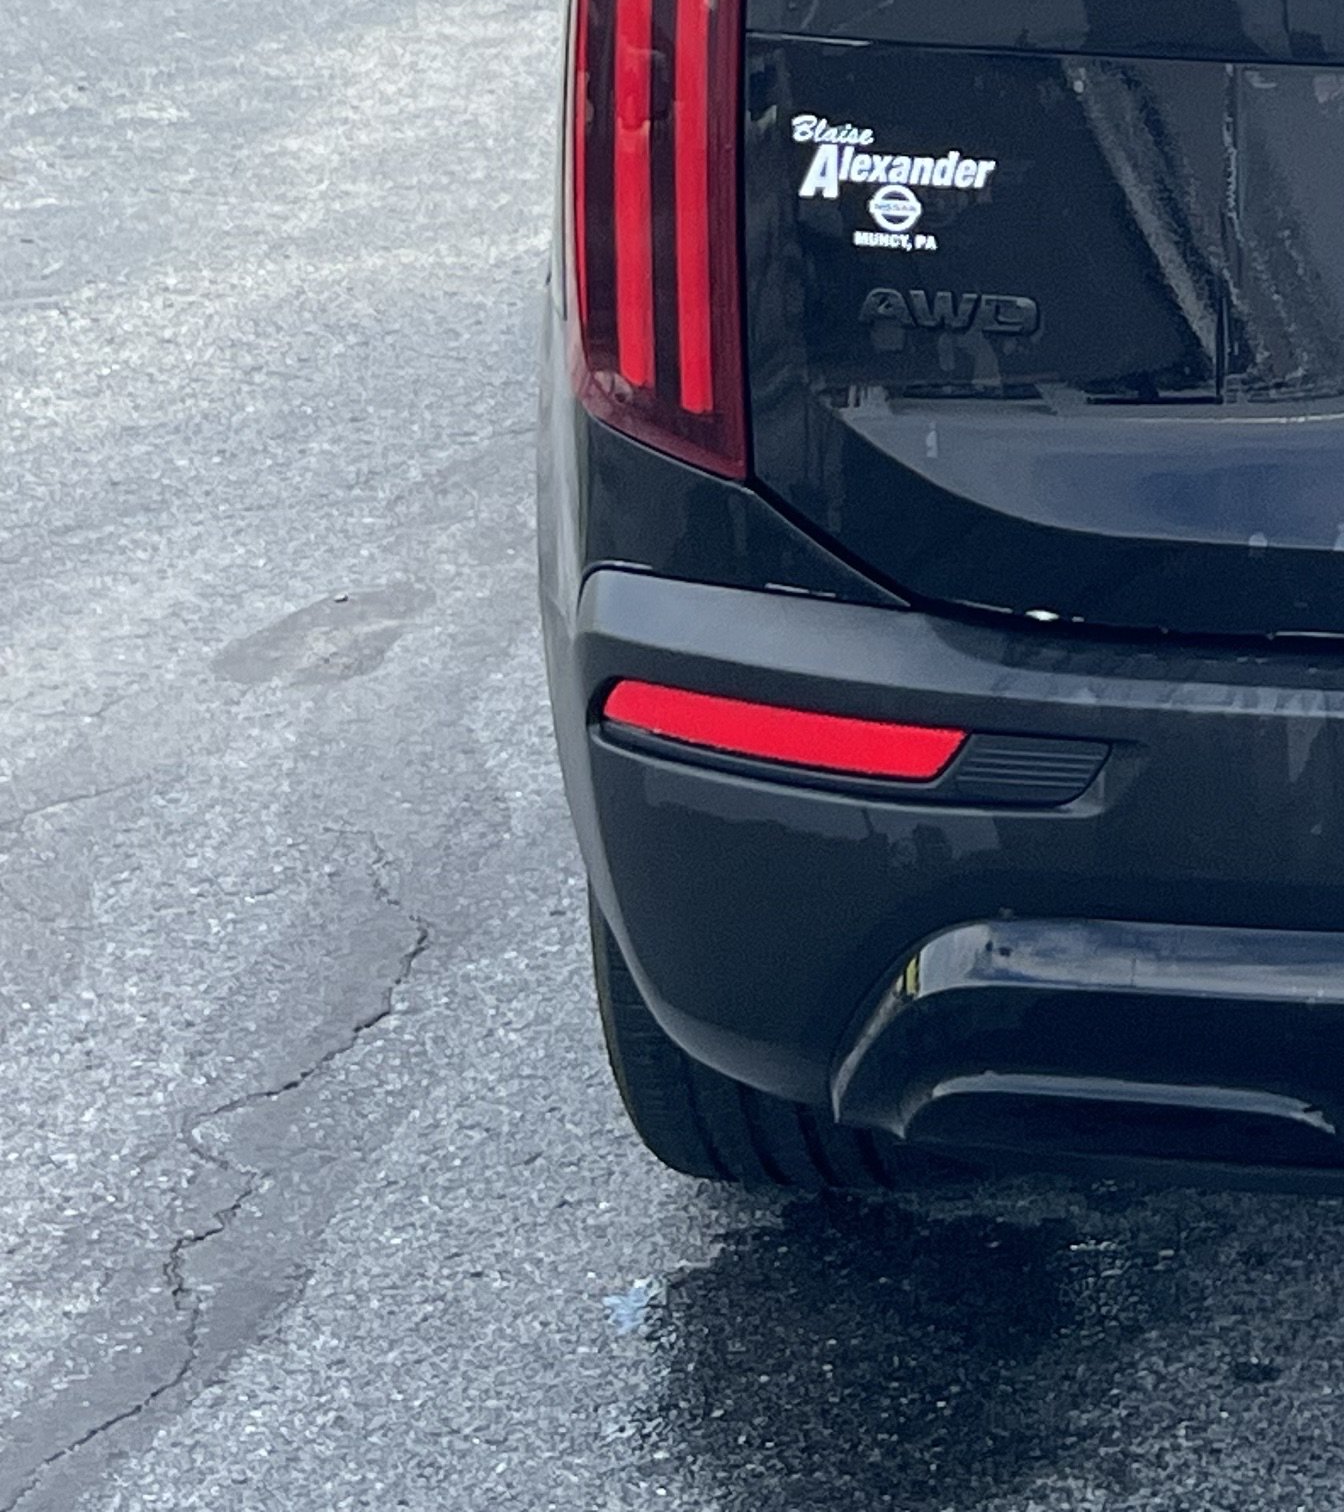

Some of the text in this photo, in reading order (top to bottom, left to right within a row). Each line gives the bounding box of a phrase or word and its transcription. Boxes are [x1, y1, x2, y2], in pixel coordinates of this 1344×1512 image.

[791, 114, 875, 146] Blaise
[799, 143, 997, 199] Alexander
[853, 231, 938, 252] MUNCY, PA
[859, 287, 1042, 336] AWD
